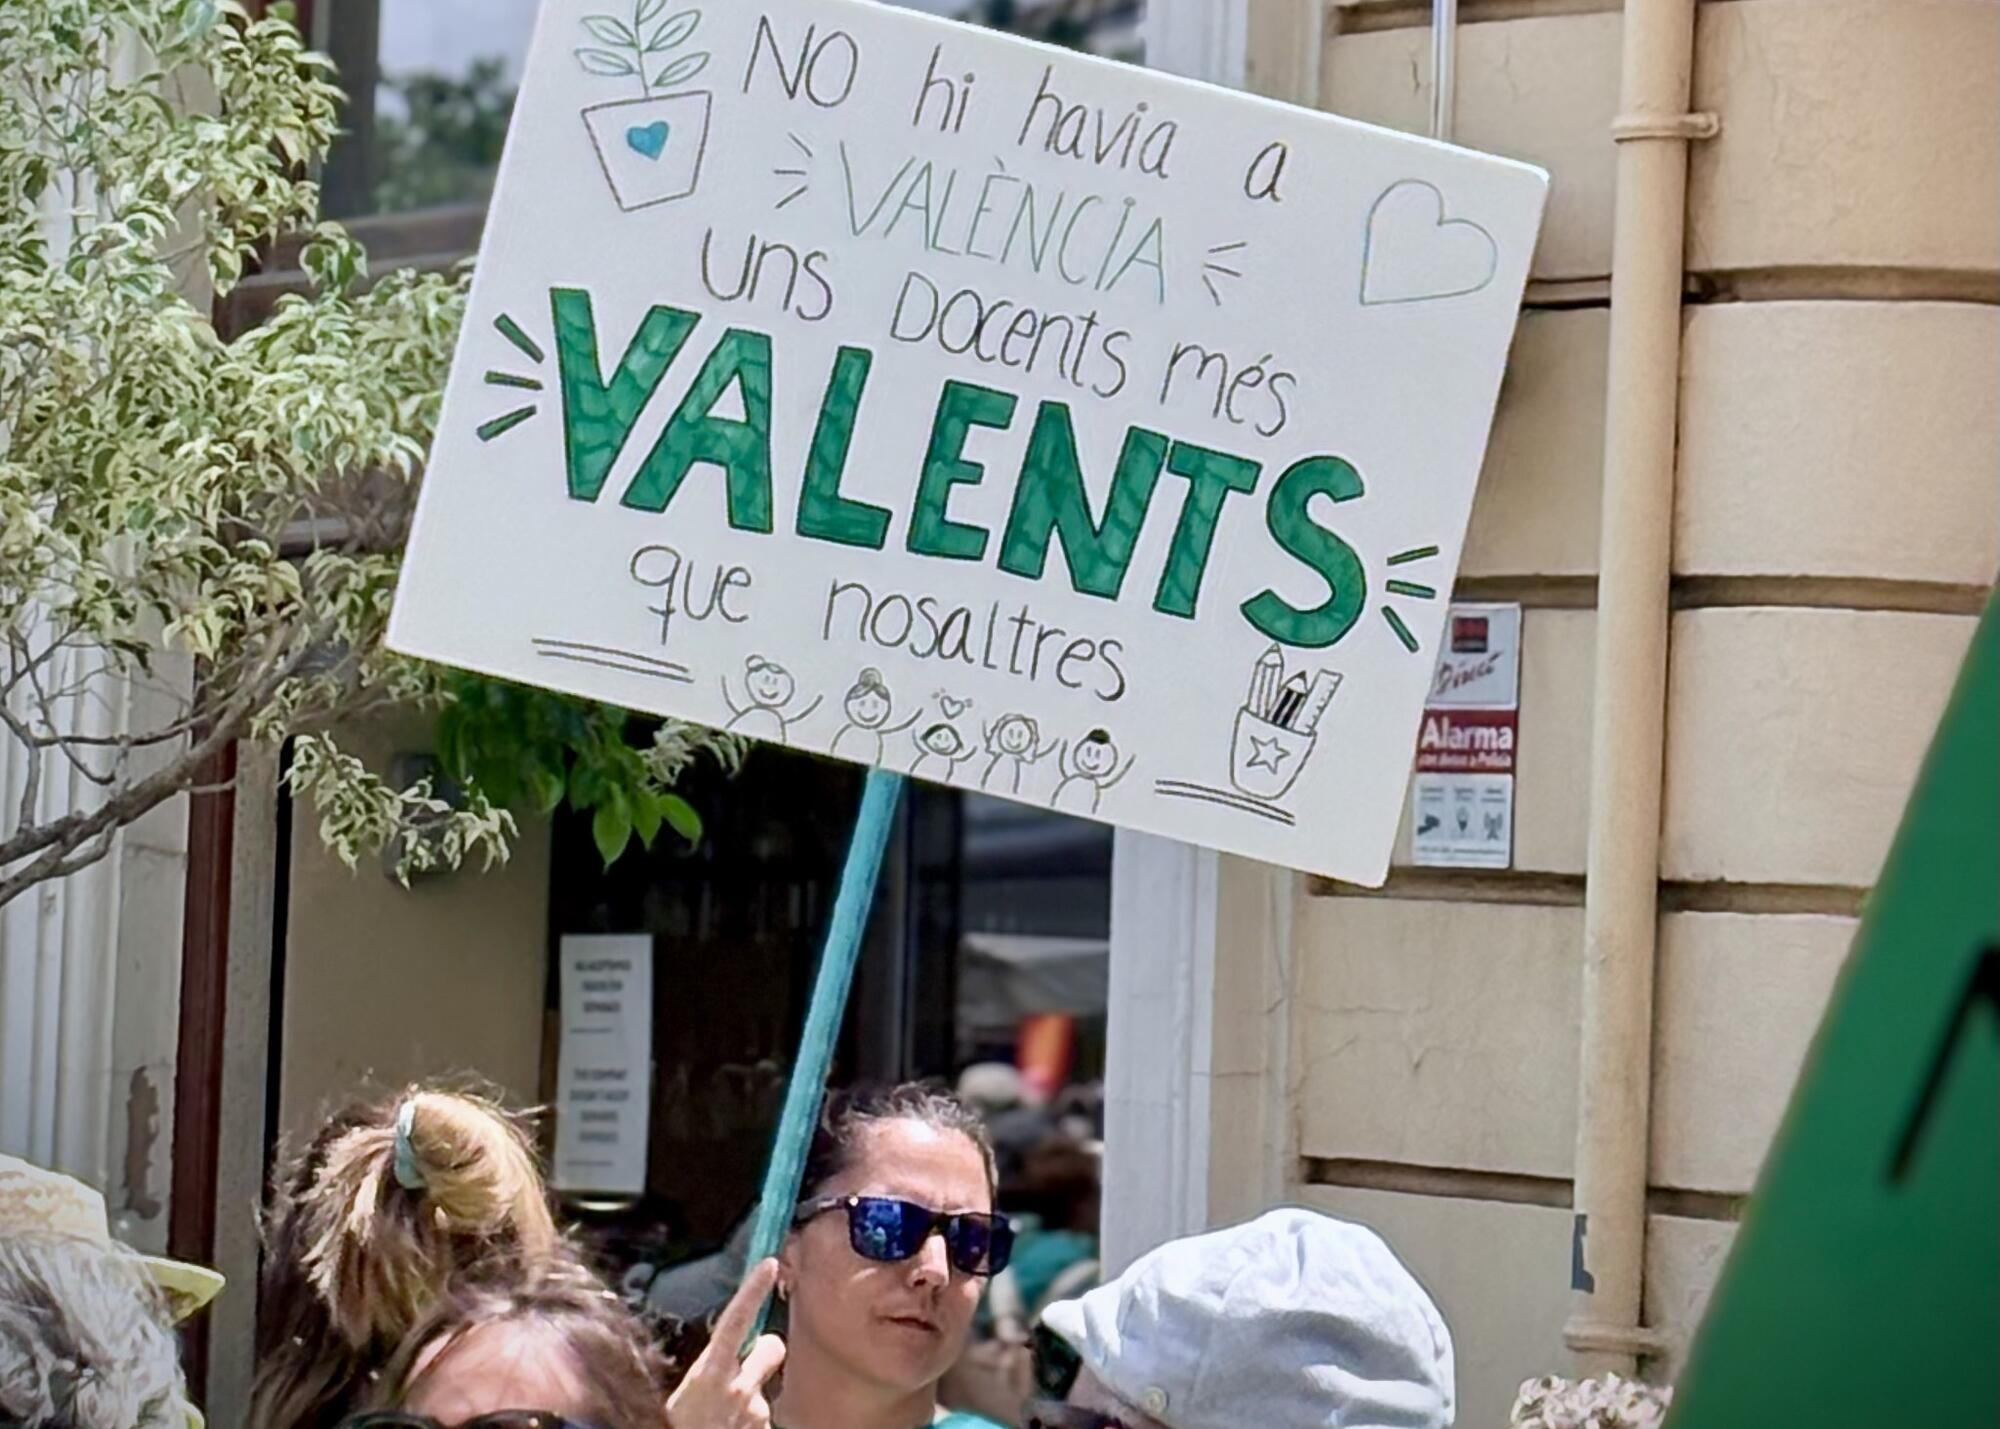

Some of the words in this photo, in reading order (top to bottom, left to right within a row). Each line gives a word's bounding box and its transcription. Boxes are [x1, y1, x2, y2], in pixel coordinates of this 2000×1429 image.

[743, 15, 859, 108] NO
[912, 43, 975, 133] hi
[1018, 65, 1178, 178] havia
[1244, 141, 1290, 202] a
[701, 227, 832, 321] uns
[1160, 341, 1297, 438] més
[548, 287, 1369, 649] VALENTS
[630, 545, 752, 645] que
[822, 578, 1126, 701] nosaltres
[1420, 717, 1513, 750] Alarma
